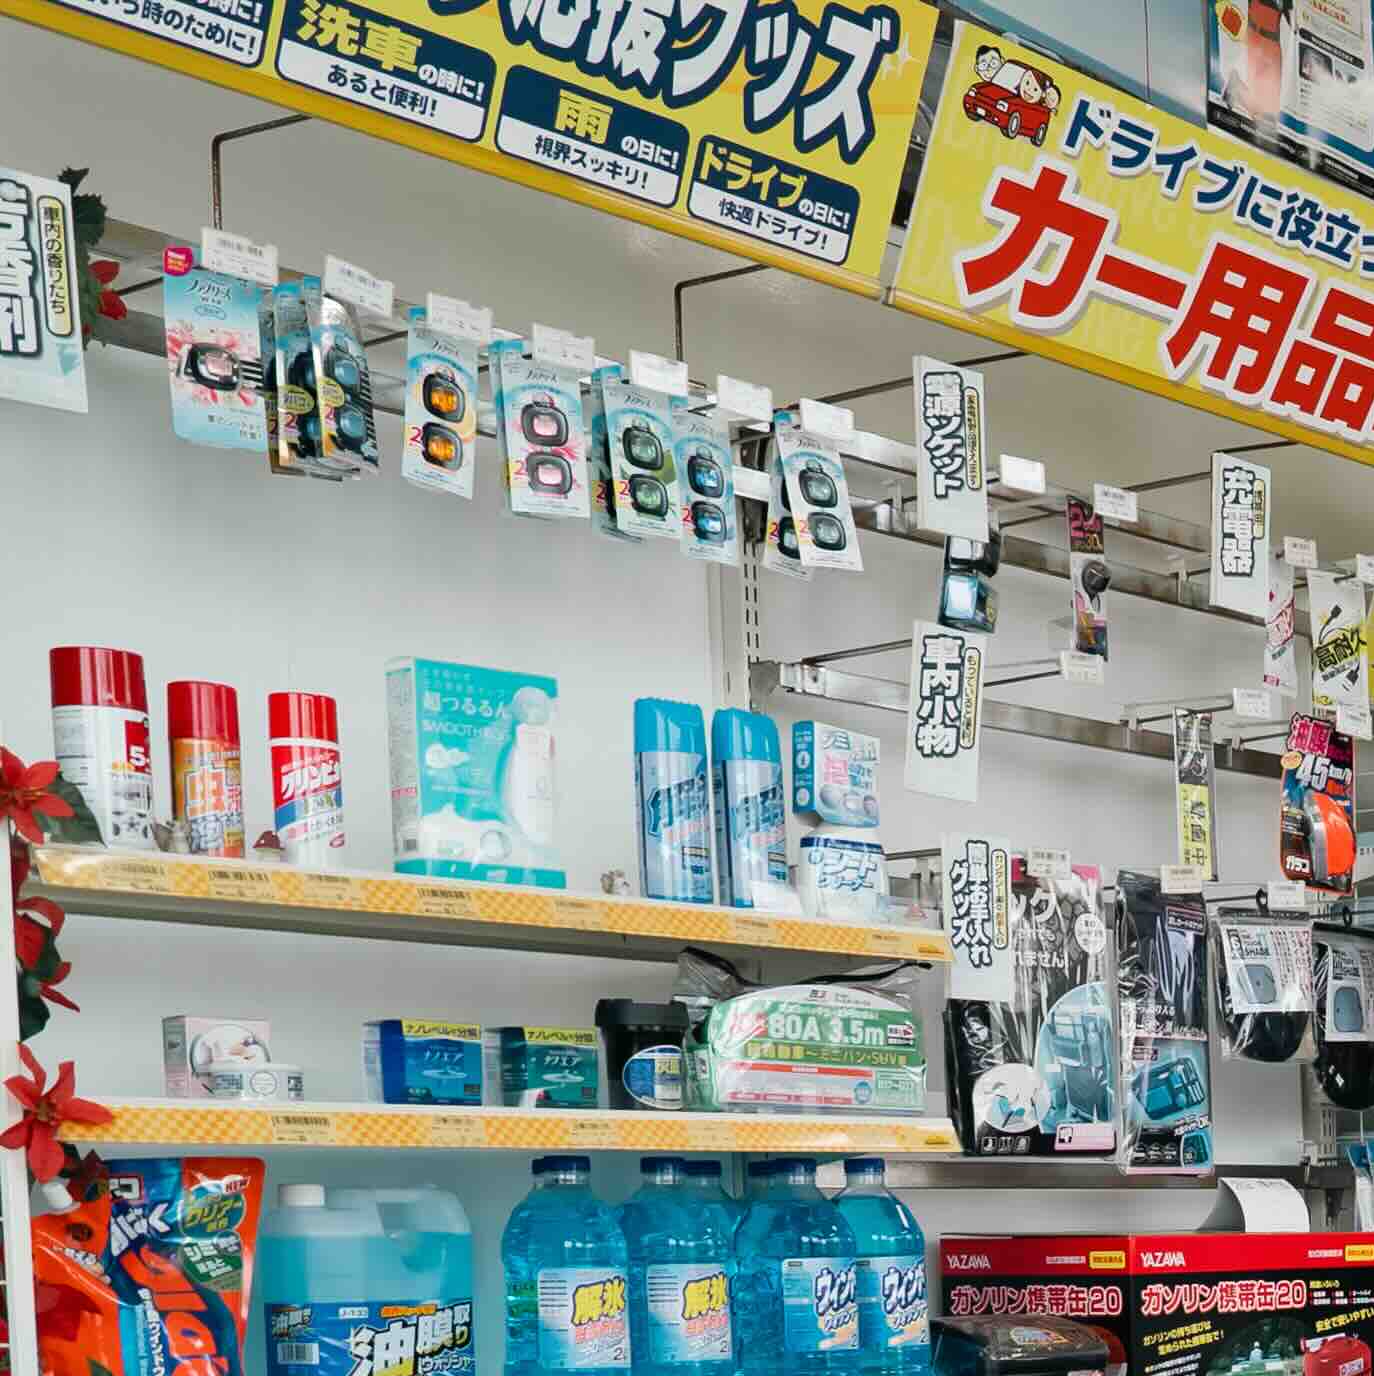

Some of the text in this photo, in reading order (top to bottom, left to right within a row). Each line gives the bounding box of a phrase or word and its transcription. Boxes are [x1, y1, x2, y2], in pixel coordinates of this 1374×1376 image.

[327, 62, 437, 118] あると便利!
[534, 135, 649, 190] 視界スッキリ!
[698, 140, 851, 231] ドライブの日に!
[717, 197, 829, 251] 快適ドライブ!
[1221, 467, 1255, 577] 充電器
[916, 634, 964, 757] 車内小物
[950, 859, 971, 948] グッズ
[946, 1254, 992, 1271] YAZAWA
[1140, 1250, 1186, 1268] YAZAWA
